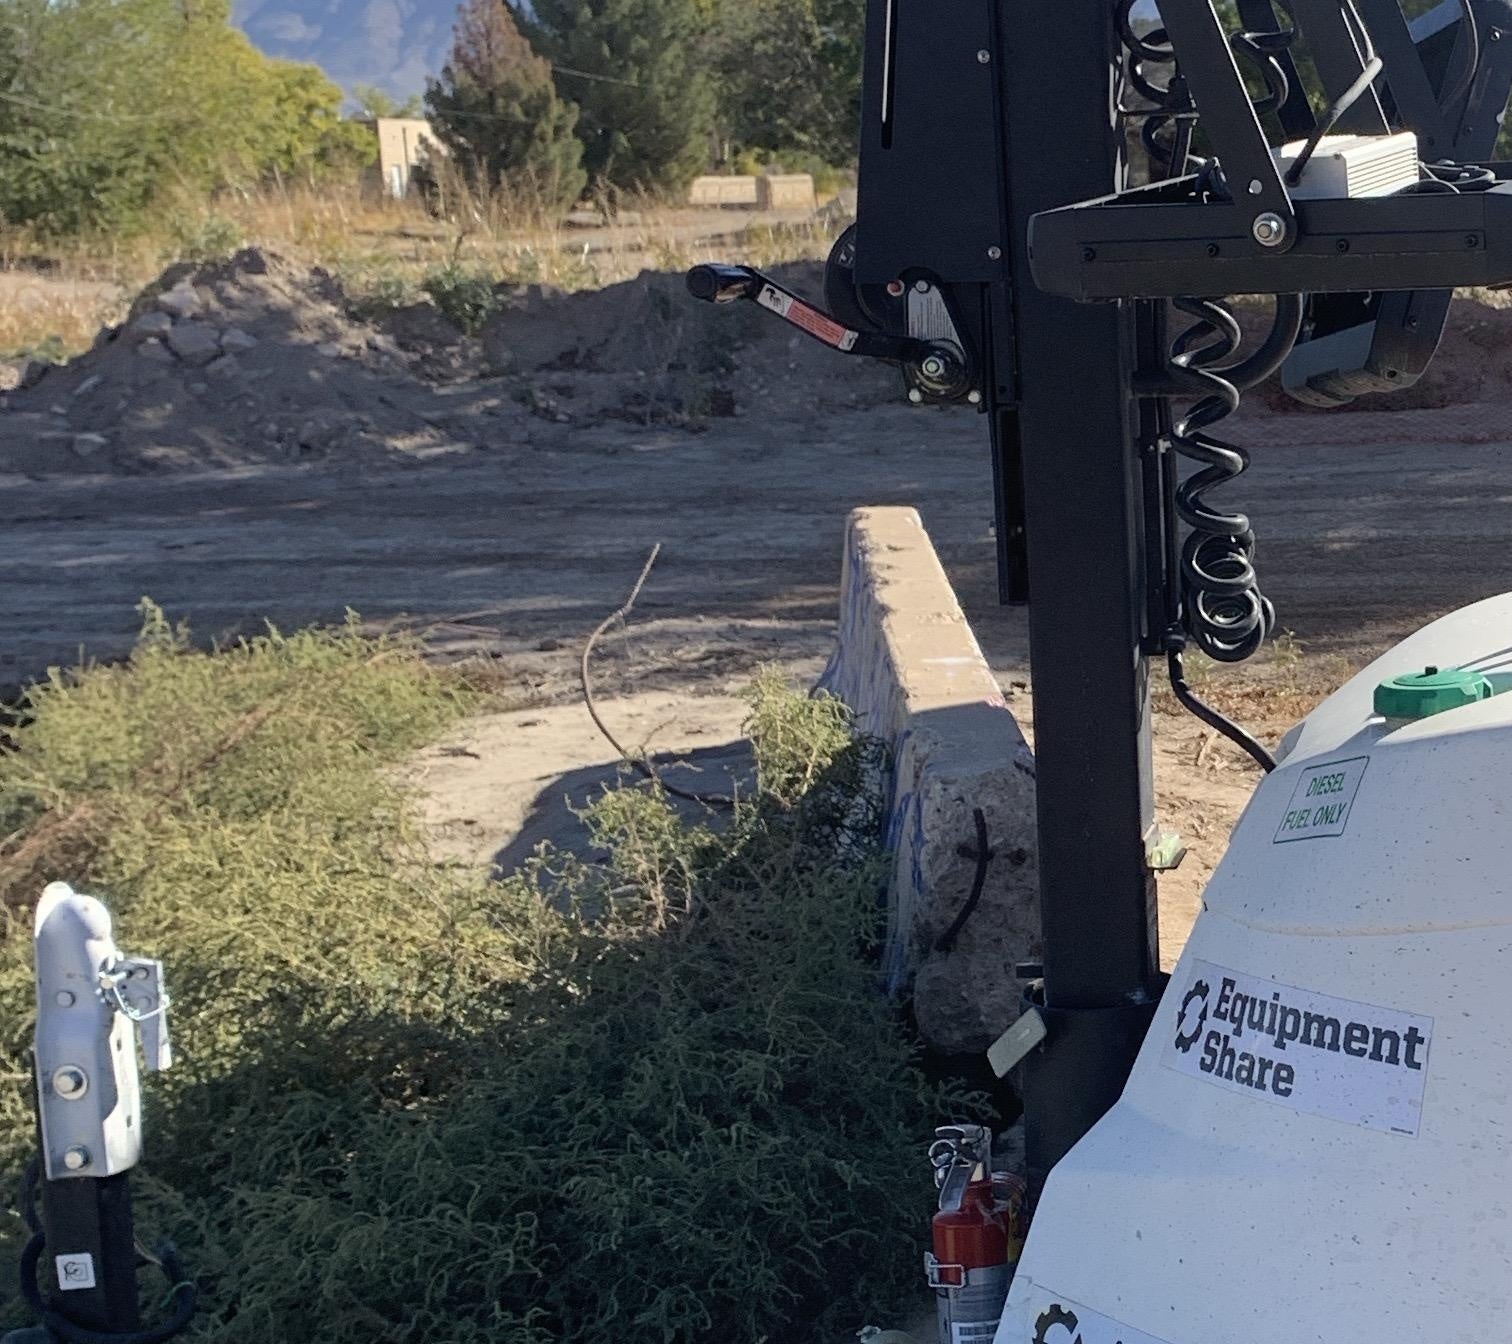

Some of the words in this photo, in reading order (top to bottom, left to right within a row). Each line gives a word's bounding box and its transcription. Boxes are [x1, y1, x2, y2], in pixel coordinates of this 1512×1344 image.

[1304, 771, 1347, 798] DIESEL
[1281, 808, 1311, 832] FUEL
[1312, 802, 1348, 827] ONLY
[1212, 977, 1426, 1070] Equipment
[1199, 1030, 1296, 1098] Share
